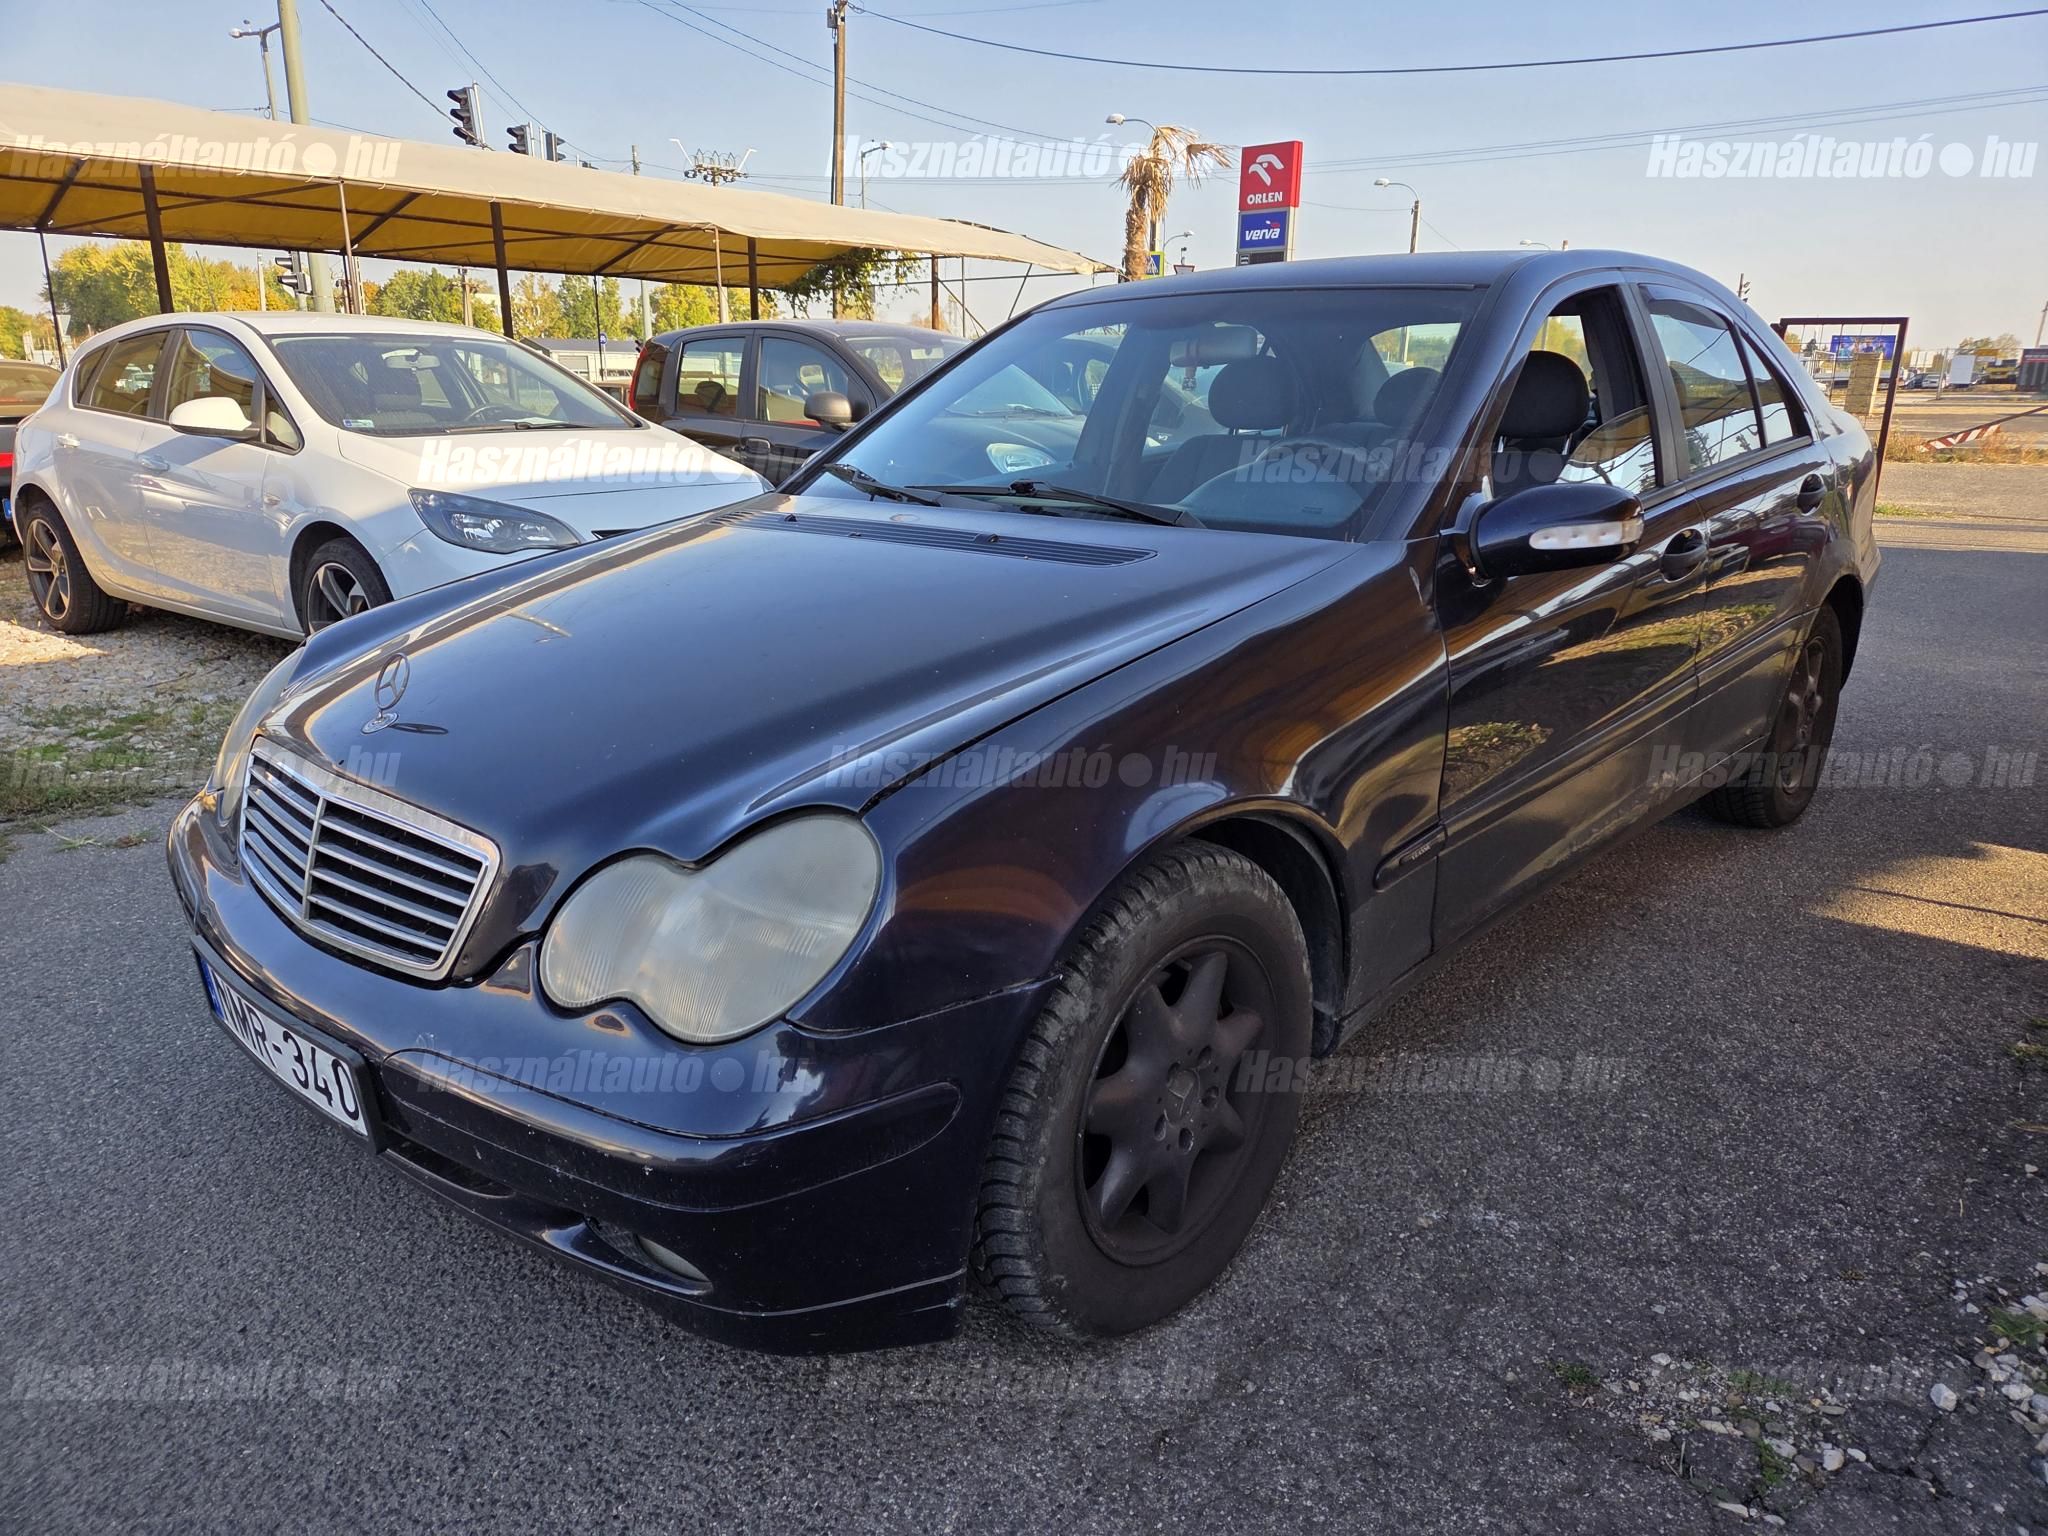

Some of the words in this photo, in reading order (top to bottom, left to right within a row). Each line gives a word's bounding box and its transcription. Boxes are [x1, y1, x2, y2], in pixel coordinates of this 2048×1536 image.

[1247, 192, 1283, 205] ORLEN
[1245, 227, 1281, 241] verva
[212, 969, 360, 1121] NMR-340
